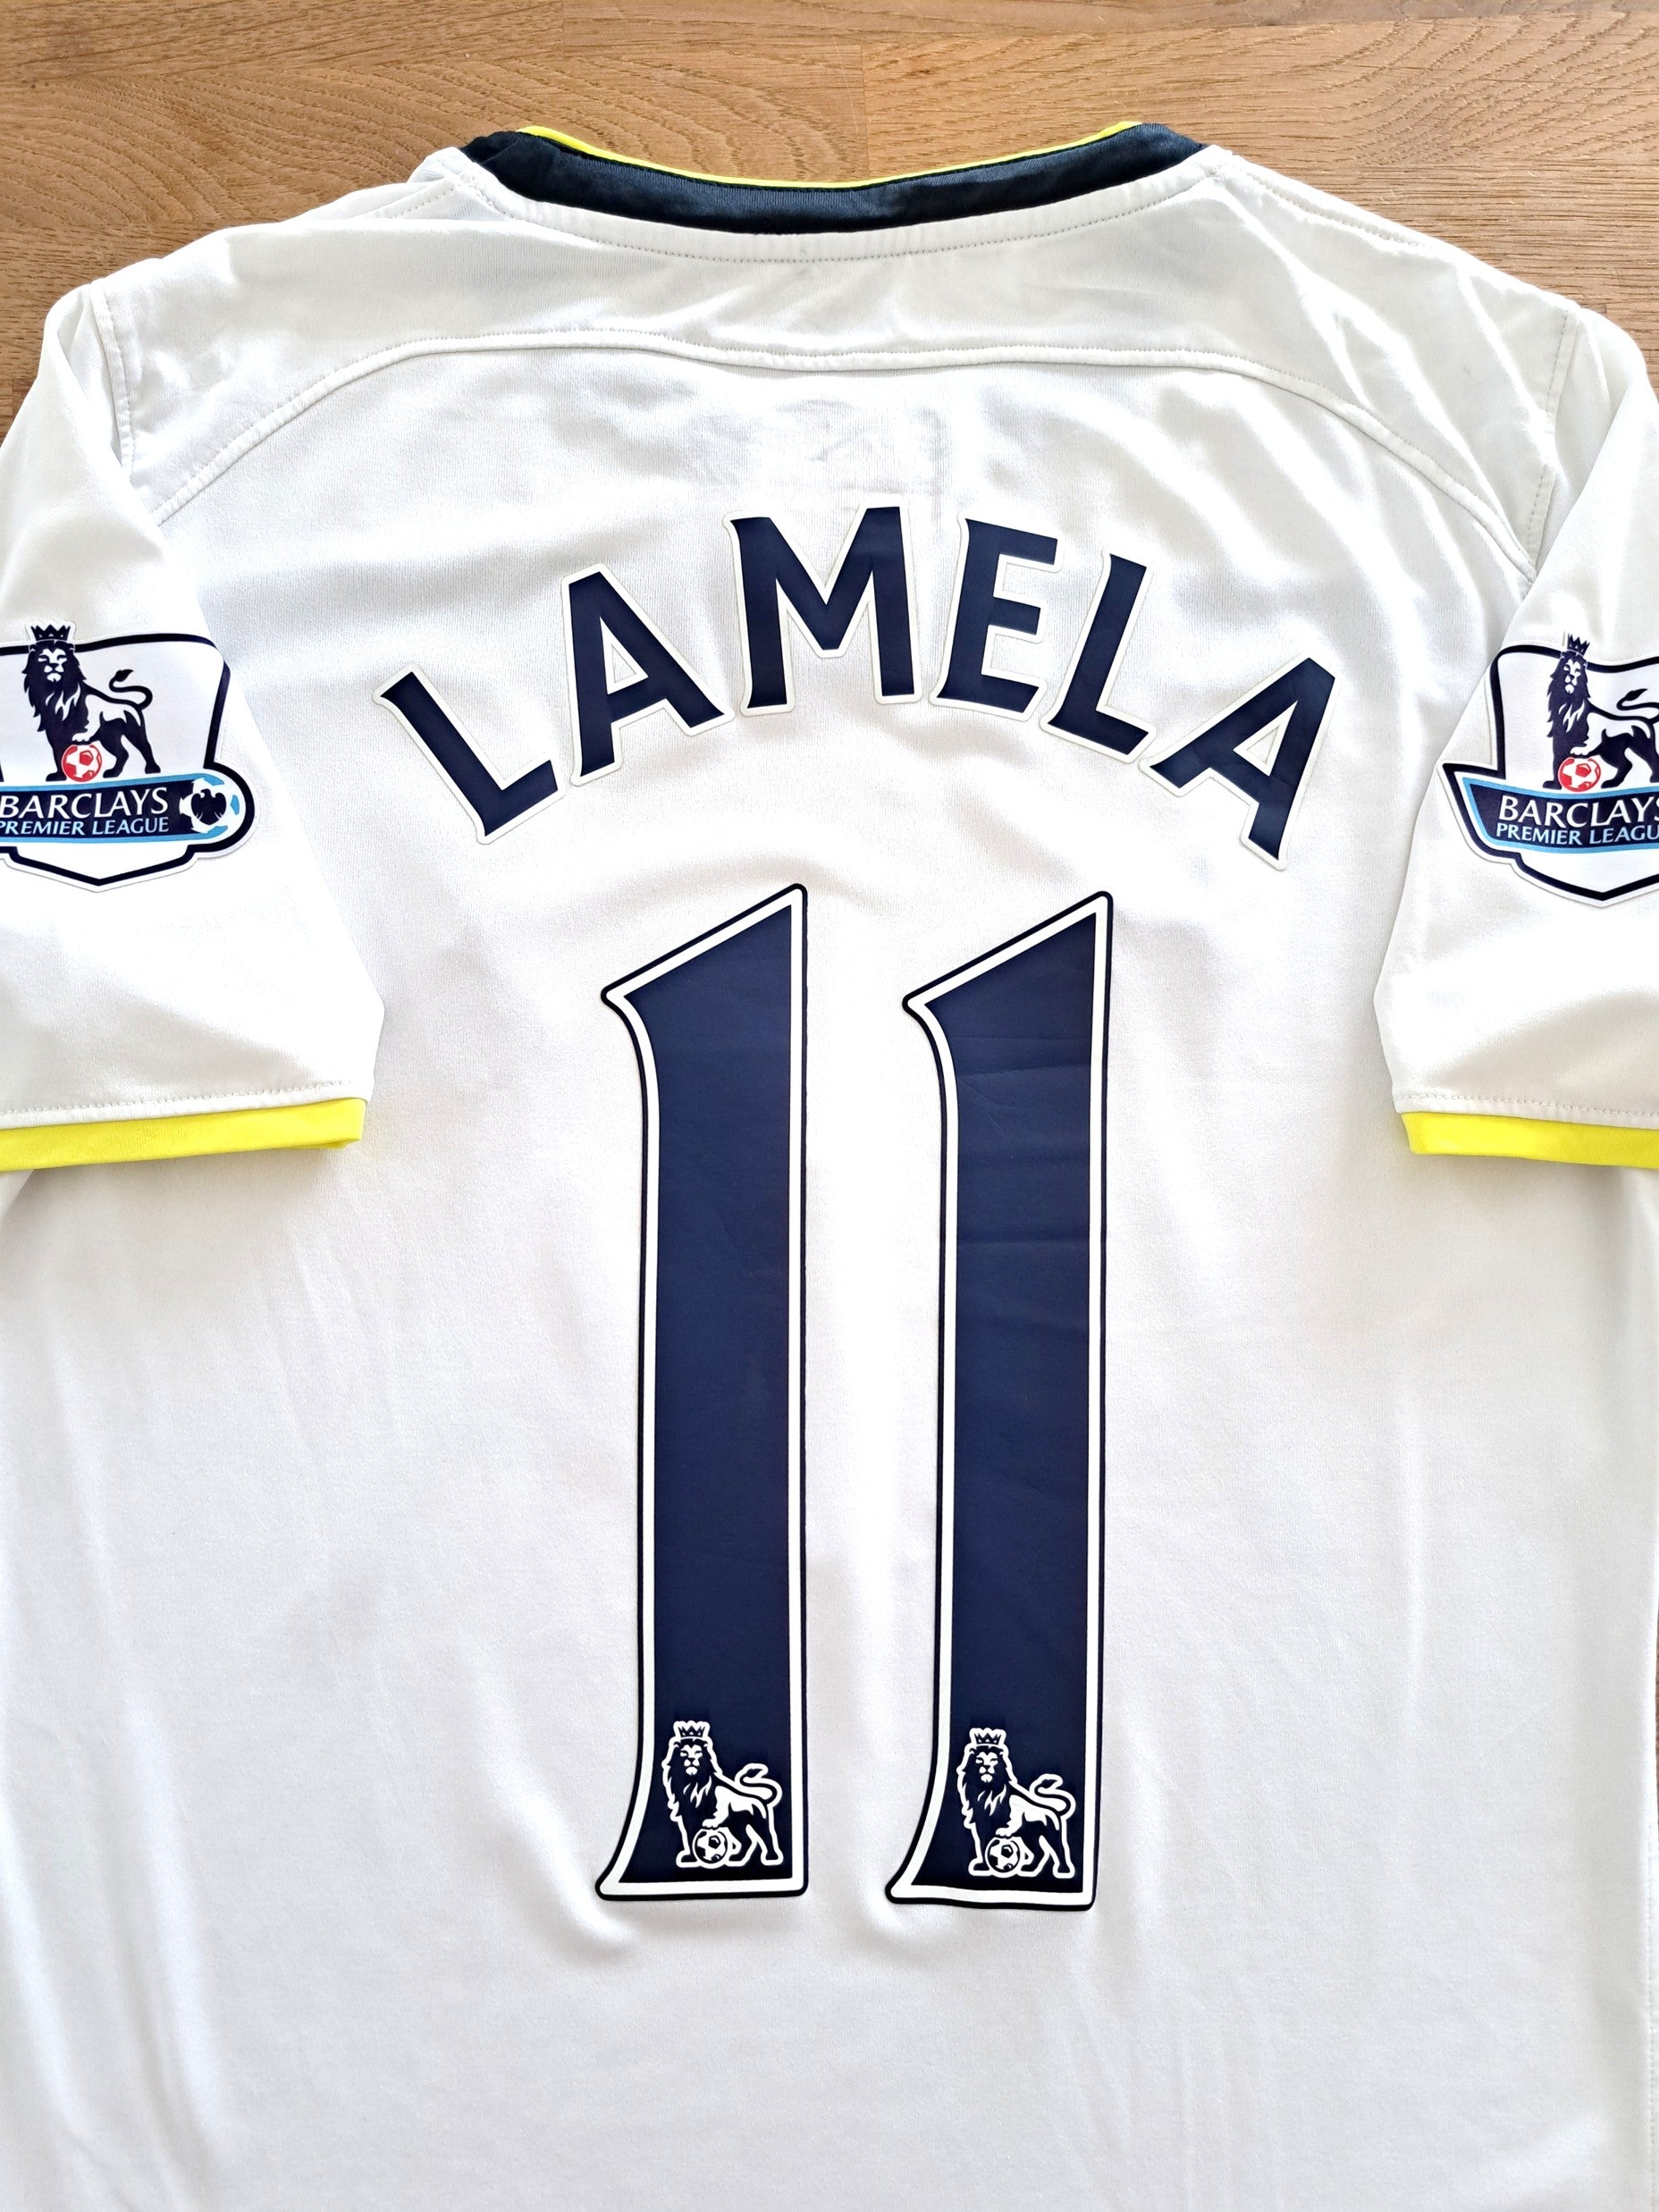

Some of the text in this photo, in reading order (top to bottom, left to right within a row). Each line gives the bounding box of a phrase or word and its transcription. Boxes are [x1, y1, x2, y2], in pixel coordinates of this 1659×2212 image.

[379, 504, 1337, 863] LAMELA
[0, 786, 168, 819] BARCLAYS
[1498, 795, 1659, 828] BARCLAY
[91, 817, 170, 836] LEAGUE
[1495, 822, 1583, 846] PREMIER
[596, 883, 1113, 1911] 11
